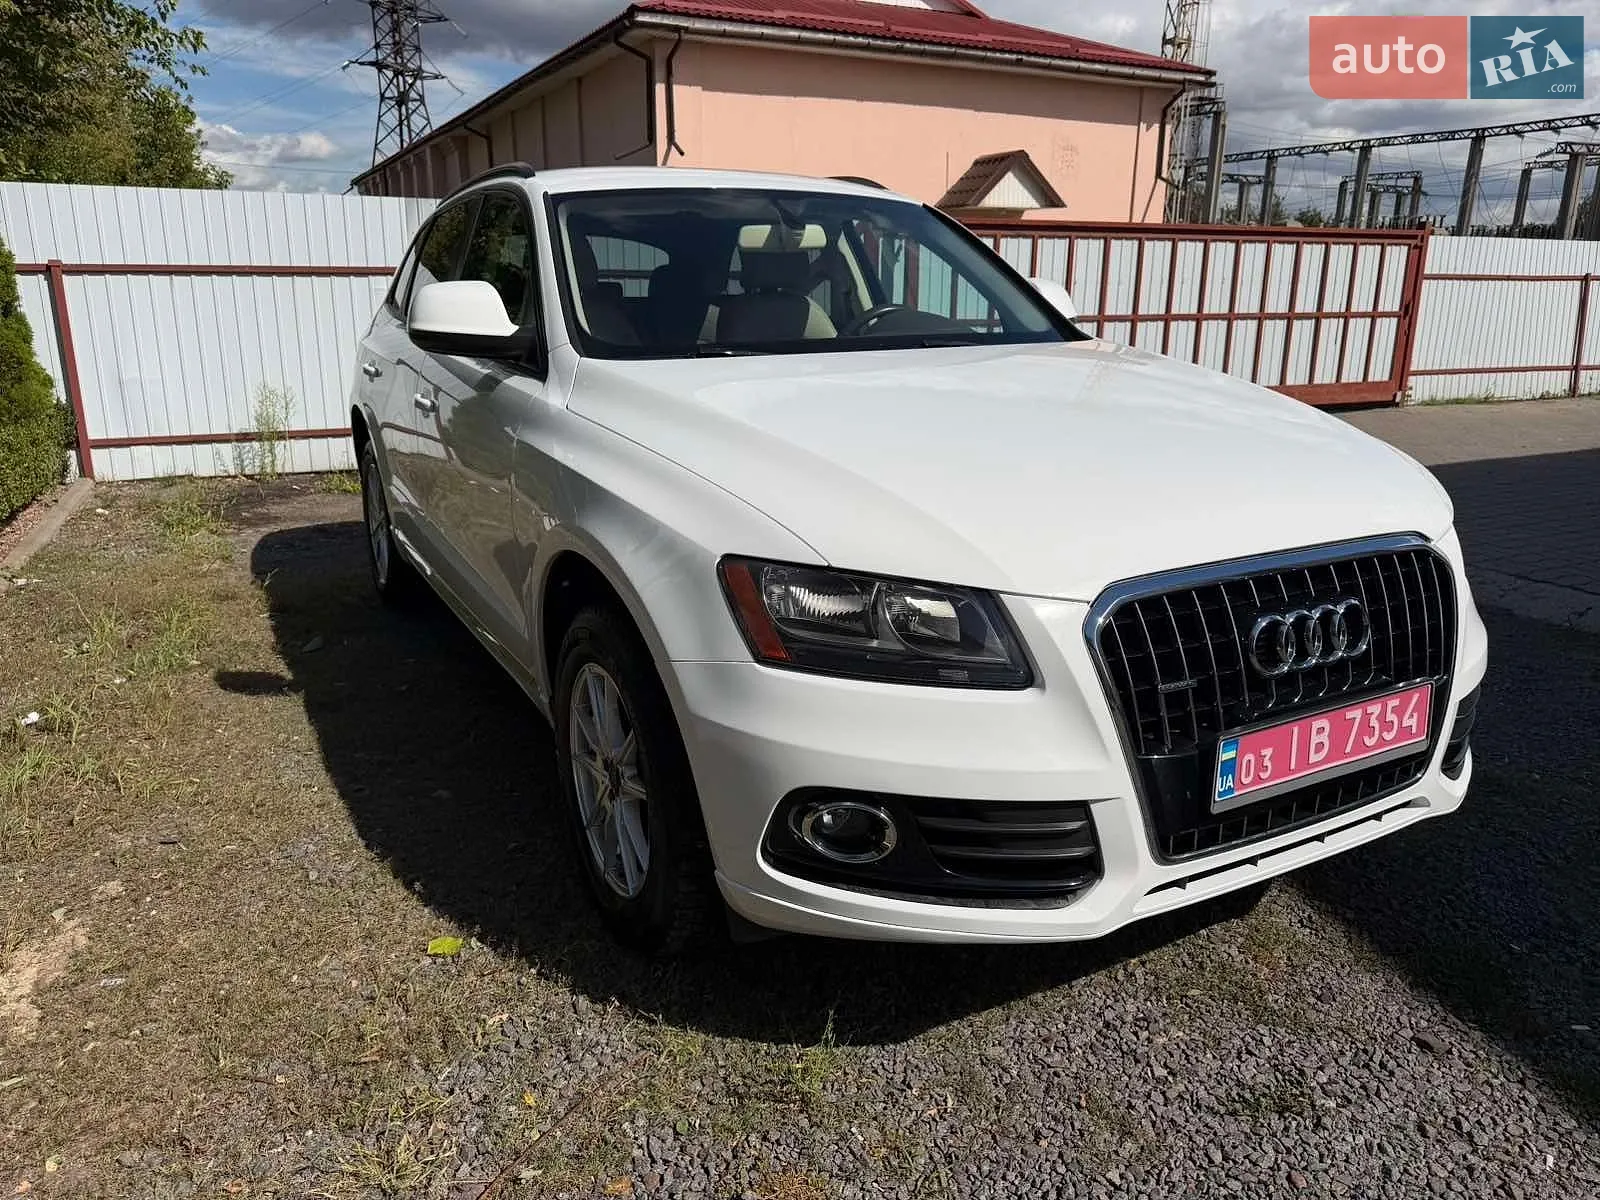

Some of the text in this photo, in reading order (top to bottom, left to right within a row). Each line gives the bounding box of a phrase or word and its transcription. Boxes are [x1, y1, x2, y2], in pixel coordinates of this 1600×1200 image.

[1240, 747, 1273, 785] 03
[1345, 693, 1420, 754] 7354
[1218, 773, 1234, 792] UA
